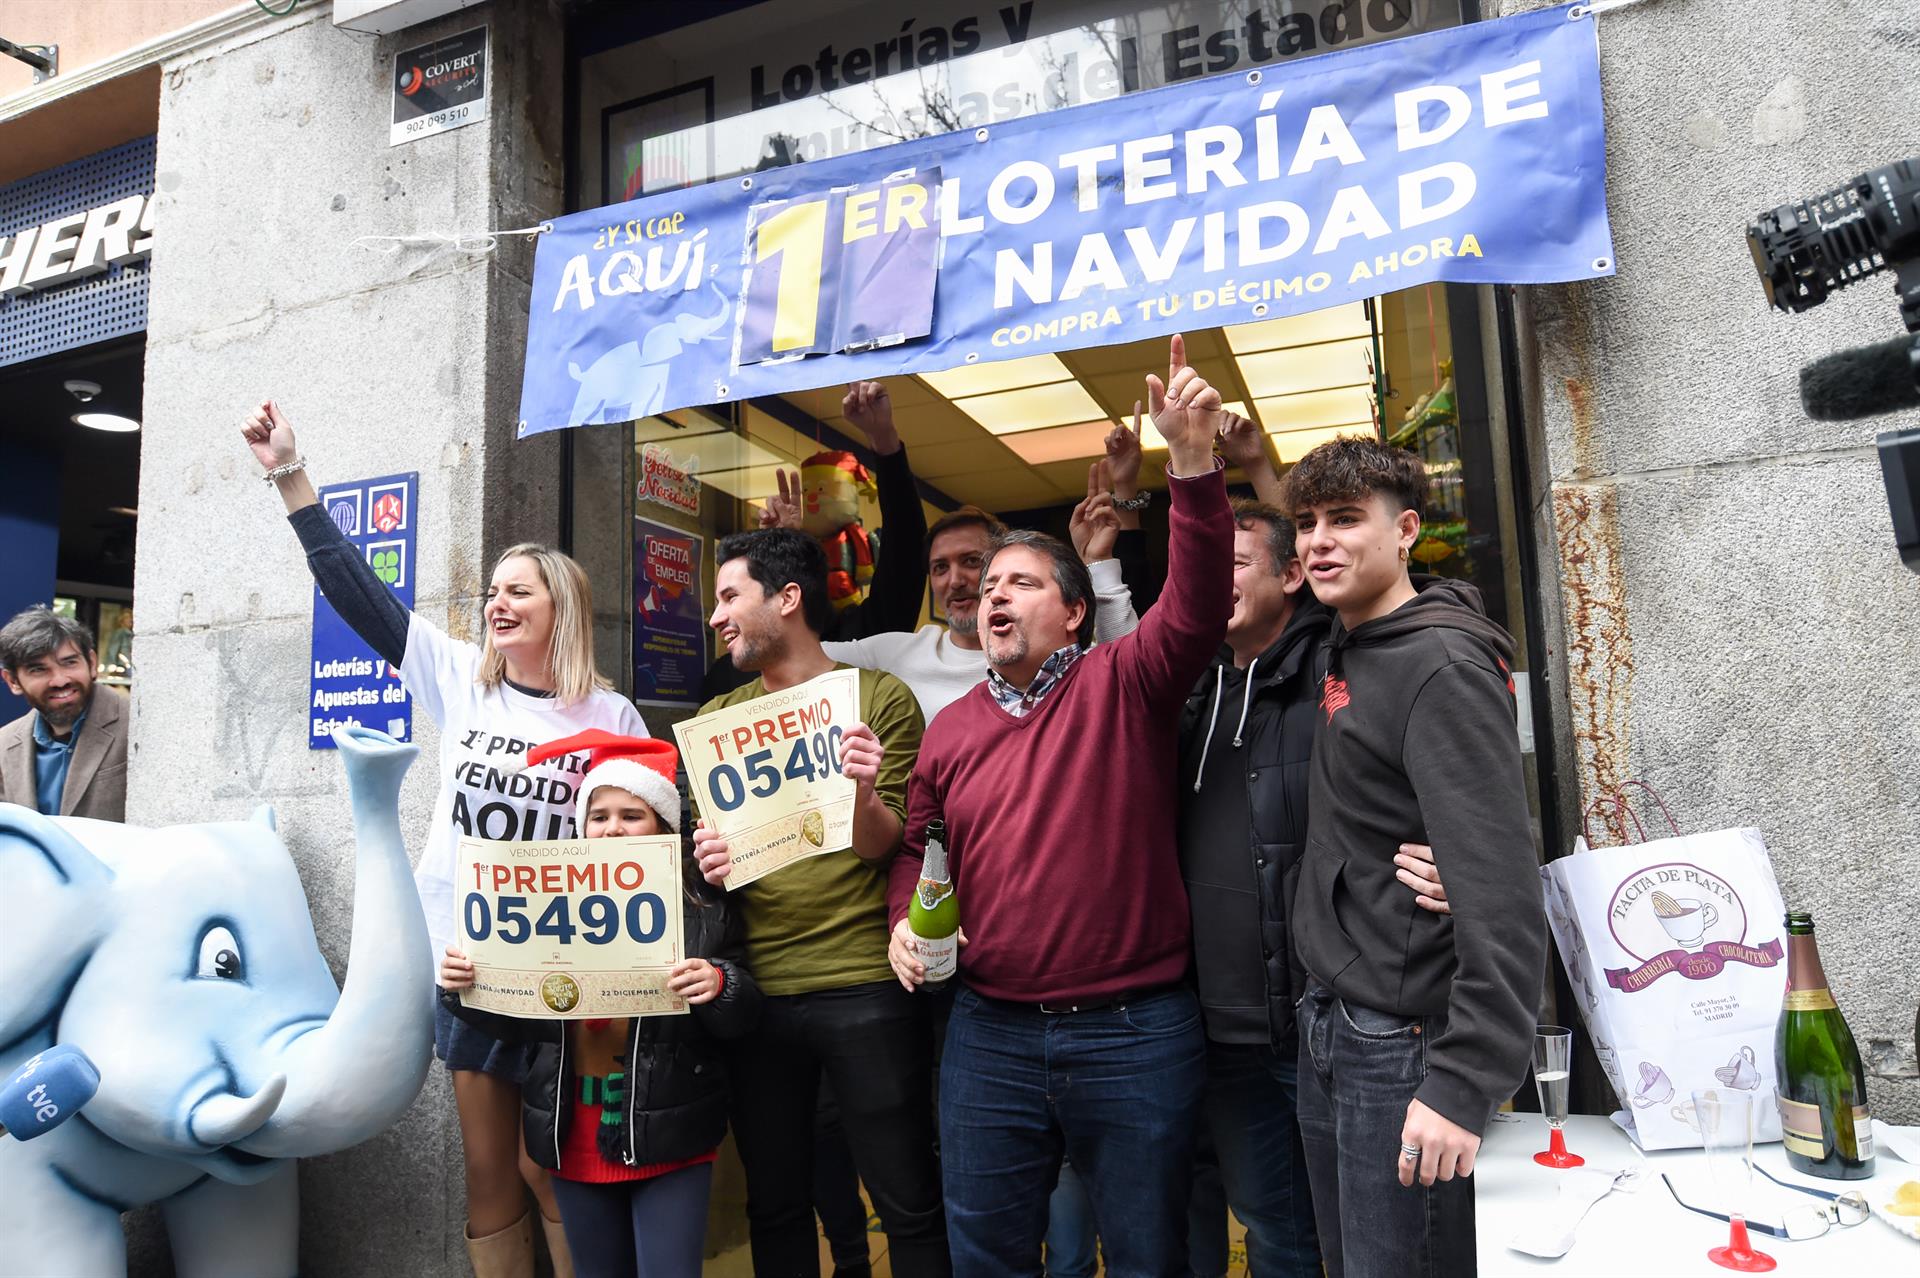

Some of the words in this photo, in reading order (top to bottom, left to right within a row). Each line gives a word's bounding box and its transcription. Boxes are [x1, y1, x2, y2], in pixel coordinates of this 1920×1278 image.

[425, 53, 478, 79] COVERT
[750, 16, 981, 111] Loterías
[999, 2, 1035, 57] y
[756, 81, 1023, 168] Apuesas
[1043, 37, 1140, 110] del
[1162, 0, 1414, 83] Estado
[406, 120, 424, 134] 902
[427, 114, 446, 128] 099
[449, 106, 469, 122] 510
[940, 90, 1366, 237] LOTERÍA
[1393, 59, 1550, 153] DE
[646, 212, 686, 239] cae
[992, 160, 1478, 309] NAVIDAD
[991, 303, 1123, 348] COMPRA
[1137, 294, 1179, 322] TU
[1193, 271, 1332, 313] DÉCIMO
[1348, 233, 1484, 285] AHORA
[650, 540, 689, 564] OFERTA
[656, 564, 690, 585] EMPLEO
[314, 656, 373, 679] Loterías
[376, 657, 386, 675] y
[313, 686, 380, 711] Apuestas
[382, 683, 406, 703] del
[744, 696, 791, 717] VENDIDO
[732, 697, 832, 755] PREMIO
[455, 760, 581, 805] VENDID
[707, 724, 844, 812] 05490
[509, 847, 559, 858] VENDIDO
[561, 844, 590, 857] AQUÍ
[731, 847, 761, 865] LOTERÍA
[766, 833, 797, 850] NAVIDAD
[492, 861, 645, 894] PREMIO
[1612, 876, 1656, 920] TACITA
[1656, 869, 1681, 884] DE
[1684, 870, 1733, 905] PLATA
[464, 891, 667, 945] 05490
[1627, 955, 1675, 990] CHURRERÍA
[1717, 944, 1773, 964] CHOCOLATERÍA
[1687, 956, 1711, 966] desde
[1687, 963, 1717, 977] 1900
[471, 982, 493, 992] OTERÍA
[500, 988, 535, 997] NAVIDAD
[613, 988, 660, 997] DICIEMBRE
[1704, 1011, 1734, 1022] MADRID
[26, 1083, 59, 1123] tve
